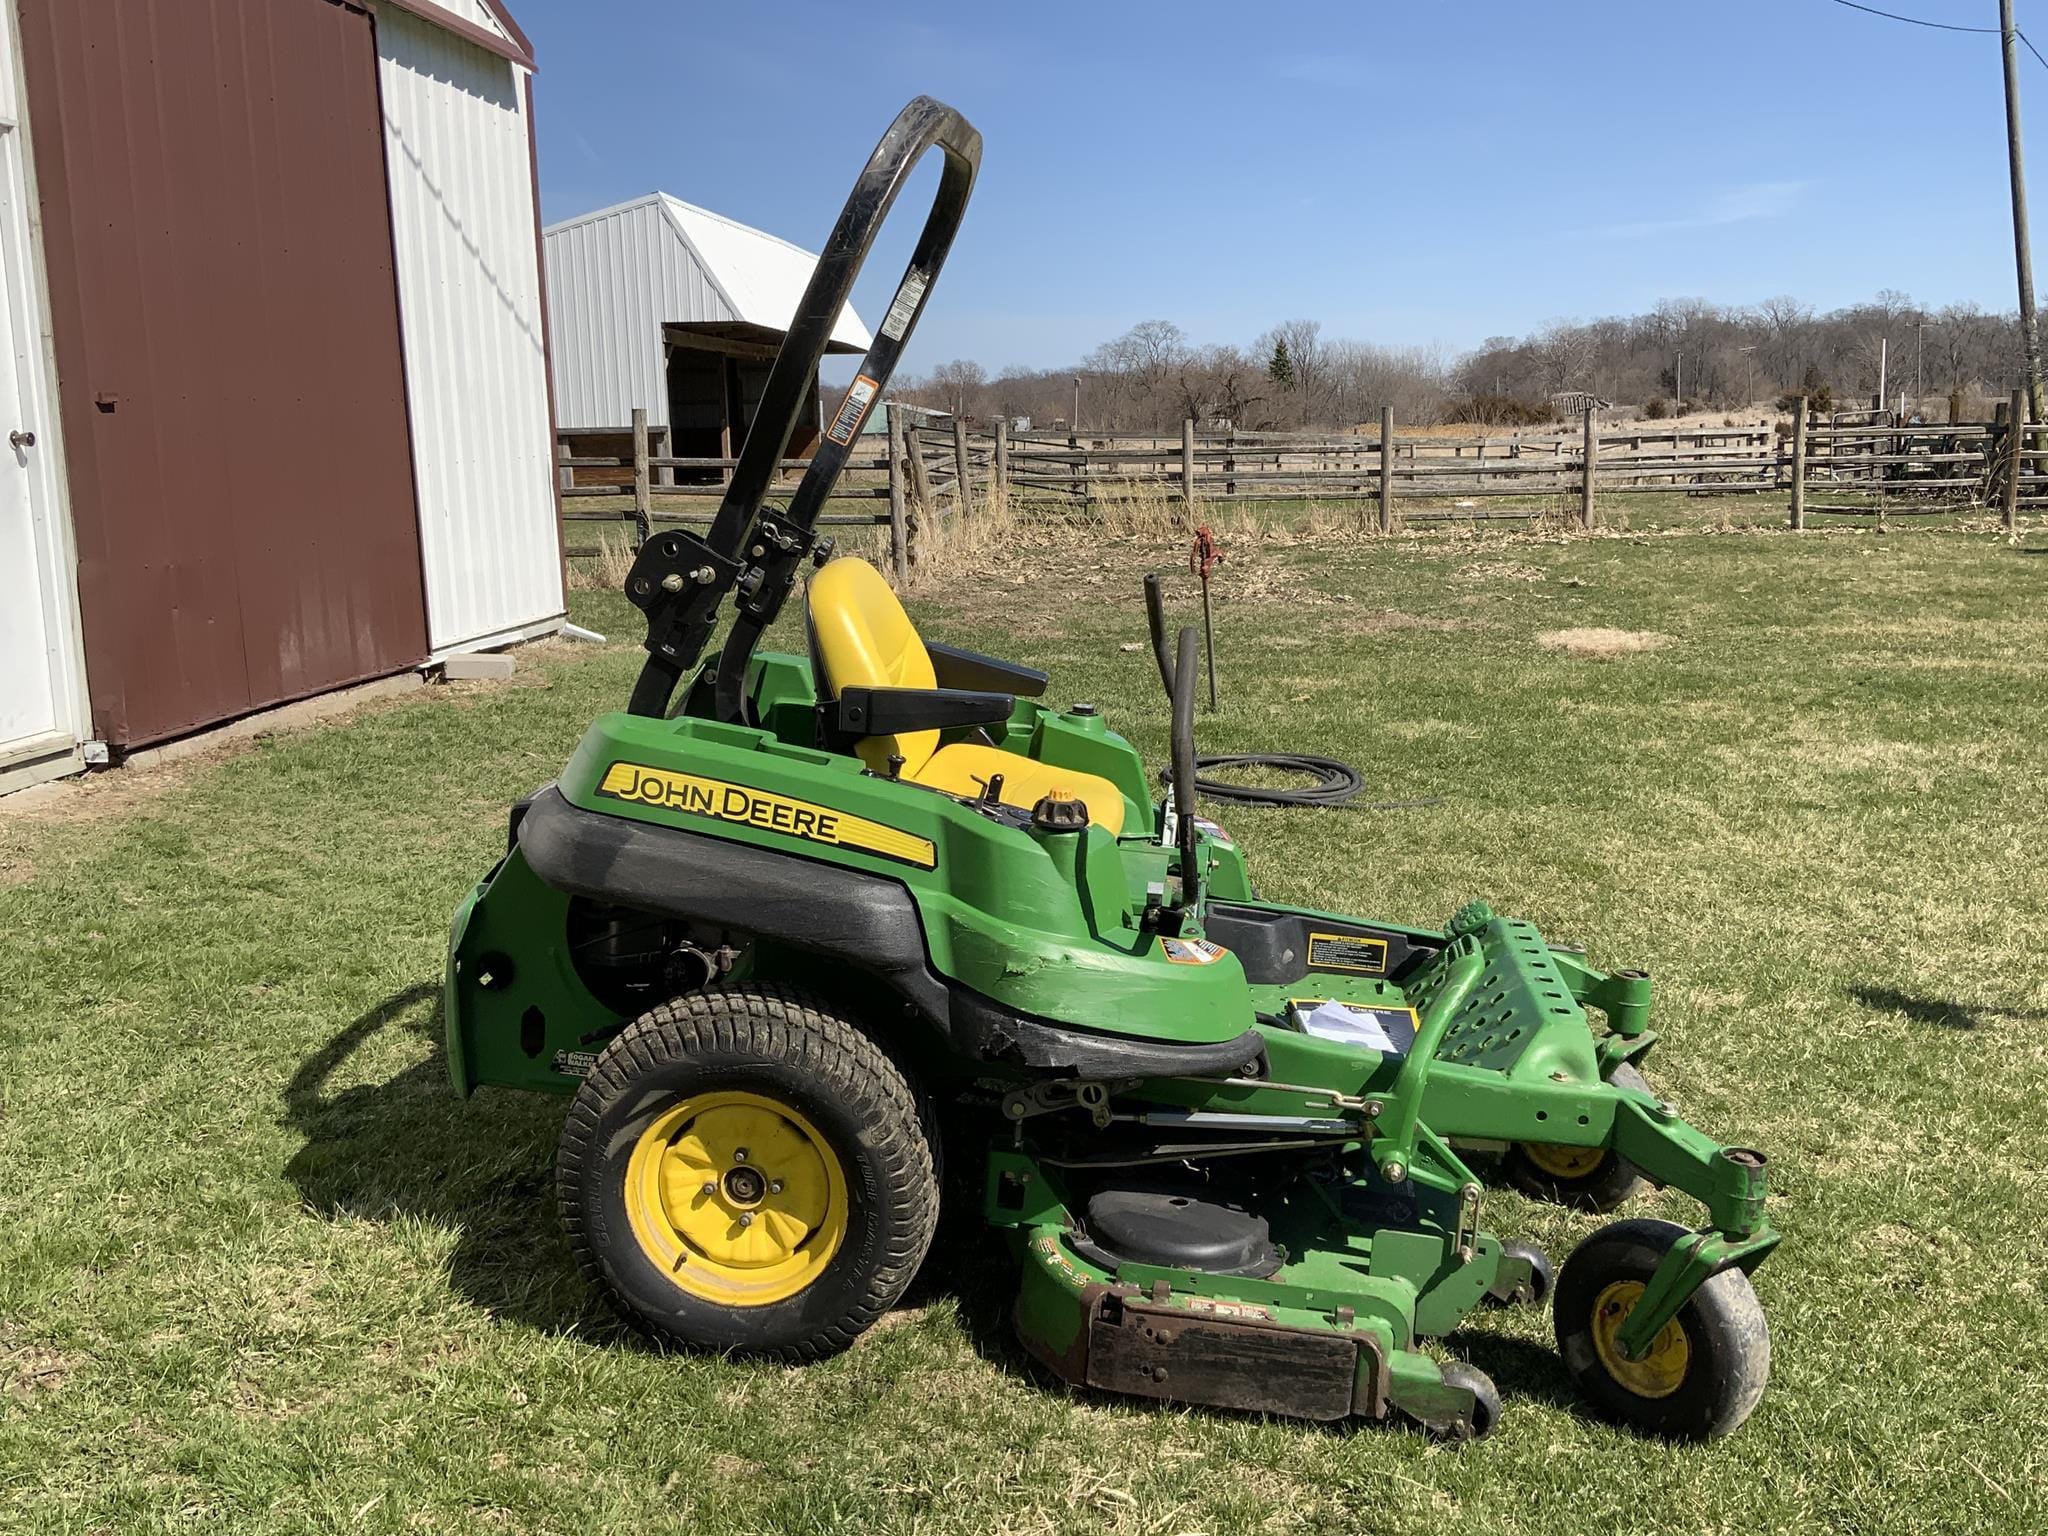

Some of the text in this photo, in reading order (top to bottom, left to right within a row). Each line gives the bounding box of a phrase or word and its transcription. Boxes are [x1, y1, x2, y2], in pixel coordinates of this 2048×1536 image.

[620, 770, 839, 839] JOHN DEERE
[1351, 1006, 1392, 1015] DEERE
